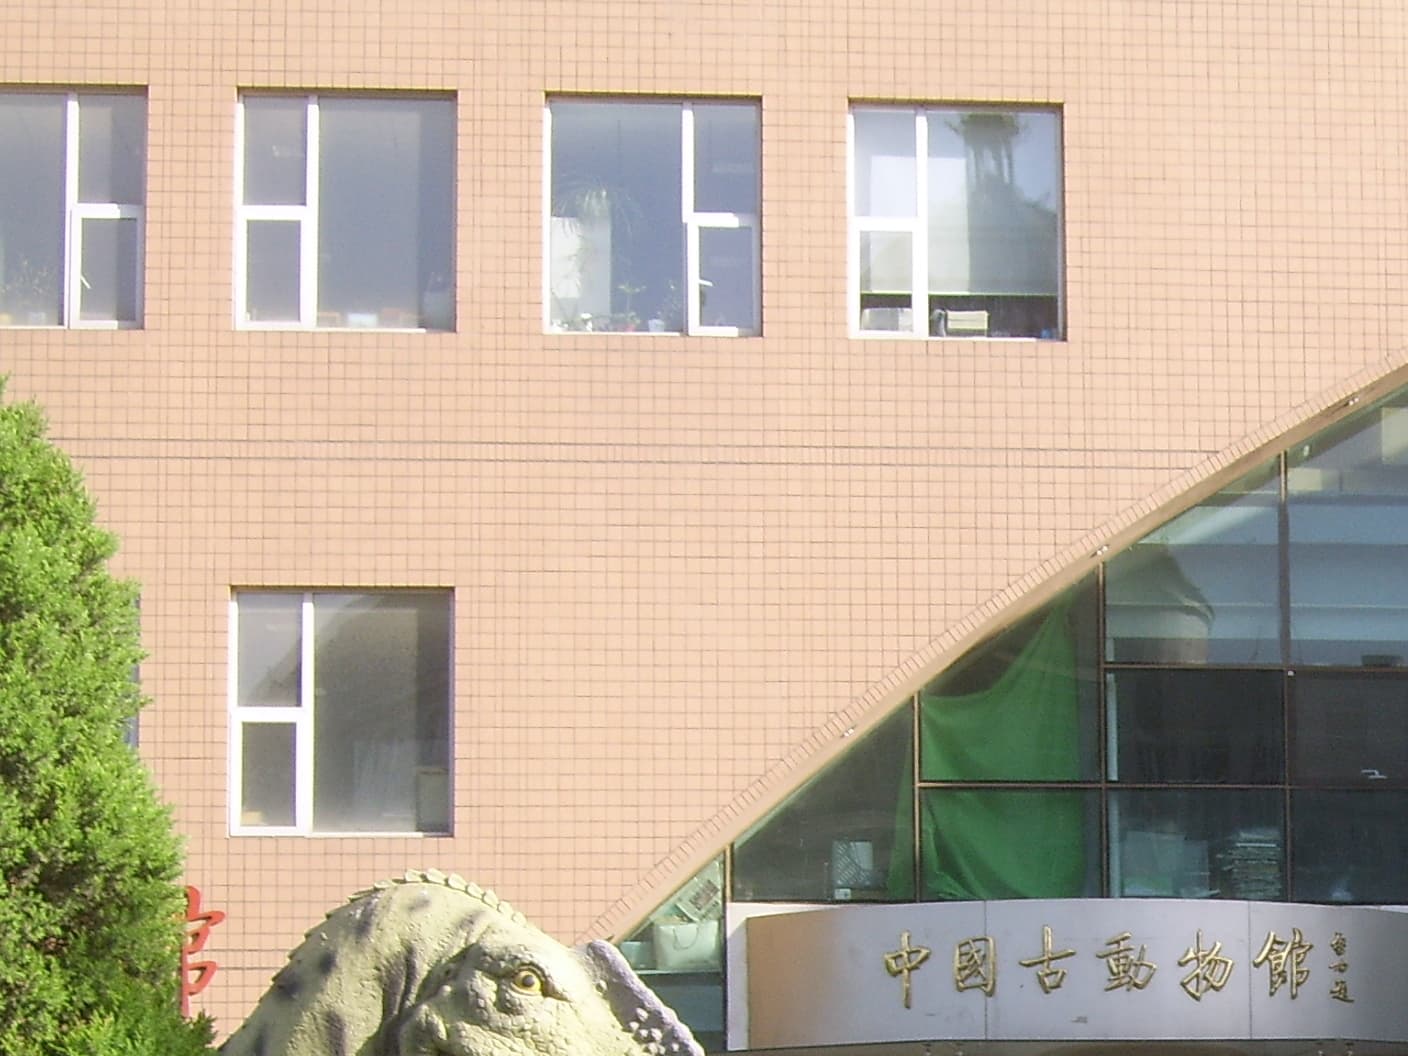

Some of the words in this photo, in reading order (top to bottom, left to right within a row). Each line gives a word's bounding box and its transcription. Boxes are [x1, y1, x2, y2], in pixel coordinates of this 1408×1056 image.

[884, 925, 1314, 1010] 中國古動物館
